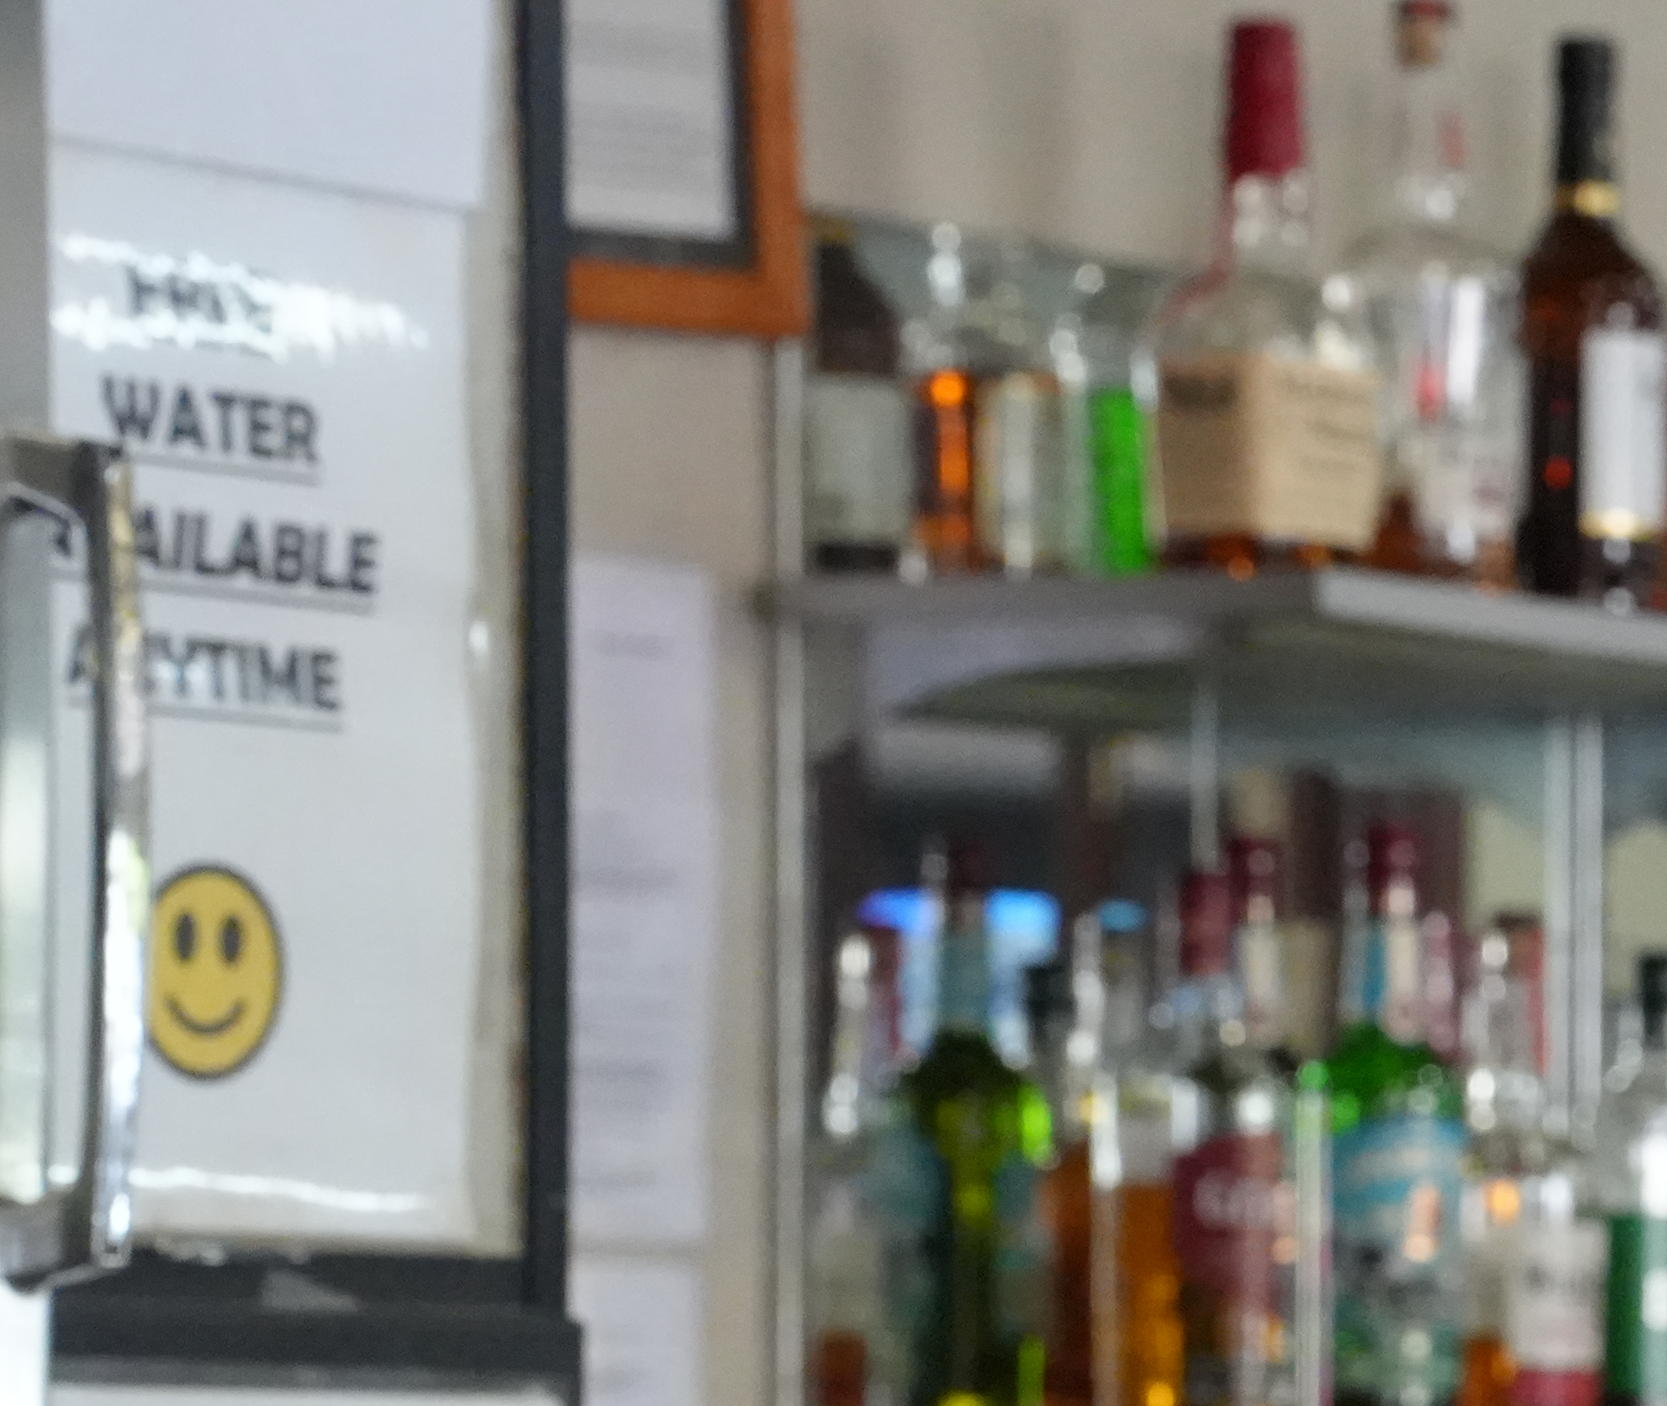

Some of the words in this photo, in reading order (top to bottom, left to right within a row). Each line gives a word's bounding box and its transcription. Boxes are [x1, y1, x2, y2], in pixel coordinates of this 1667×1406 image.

[100, 374, 320, 462] WATER
[55, 503, 378, 595] AILABLE
[67, 624, 343, 712] AYTIME
